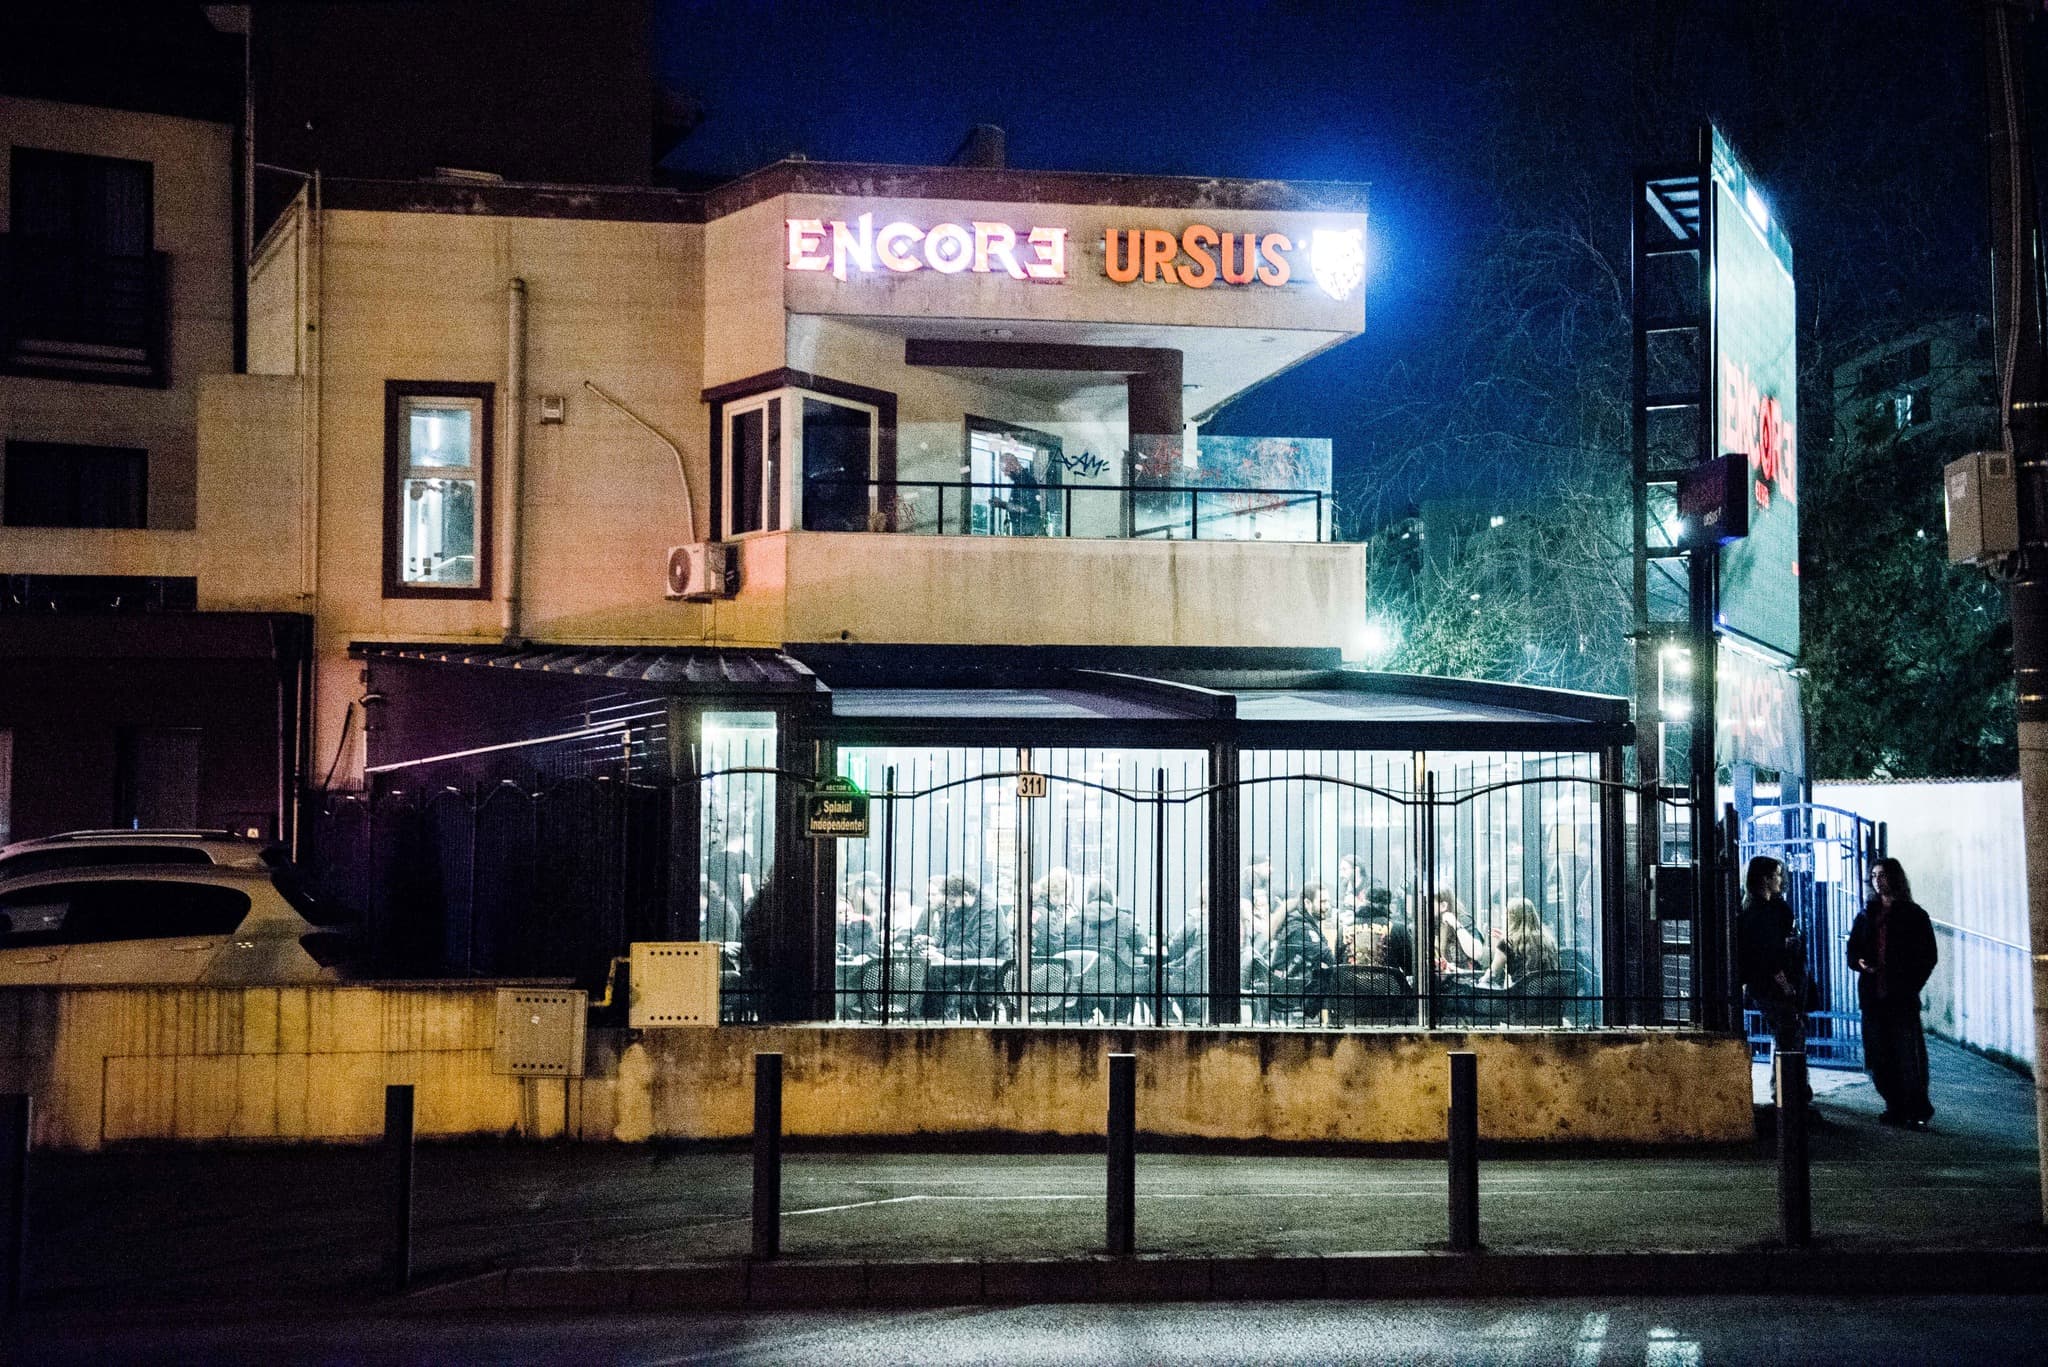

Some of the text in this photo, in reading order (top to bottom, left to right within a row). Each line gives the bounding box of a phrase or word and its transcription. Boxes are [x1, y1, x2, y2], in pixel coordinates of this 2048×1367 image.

[786, 211, 1068, 281] ENCORE
[1105, 223, 1293, 289] URSUS
[1022, 776, 1042, 794] 311
[823, 800, 852, 816] Splaiul
